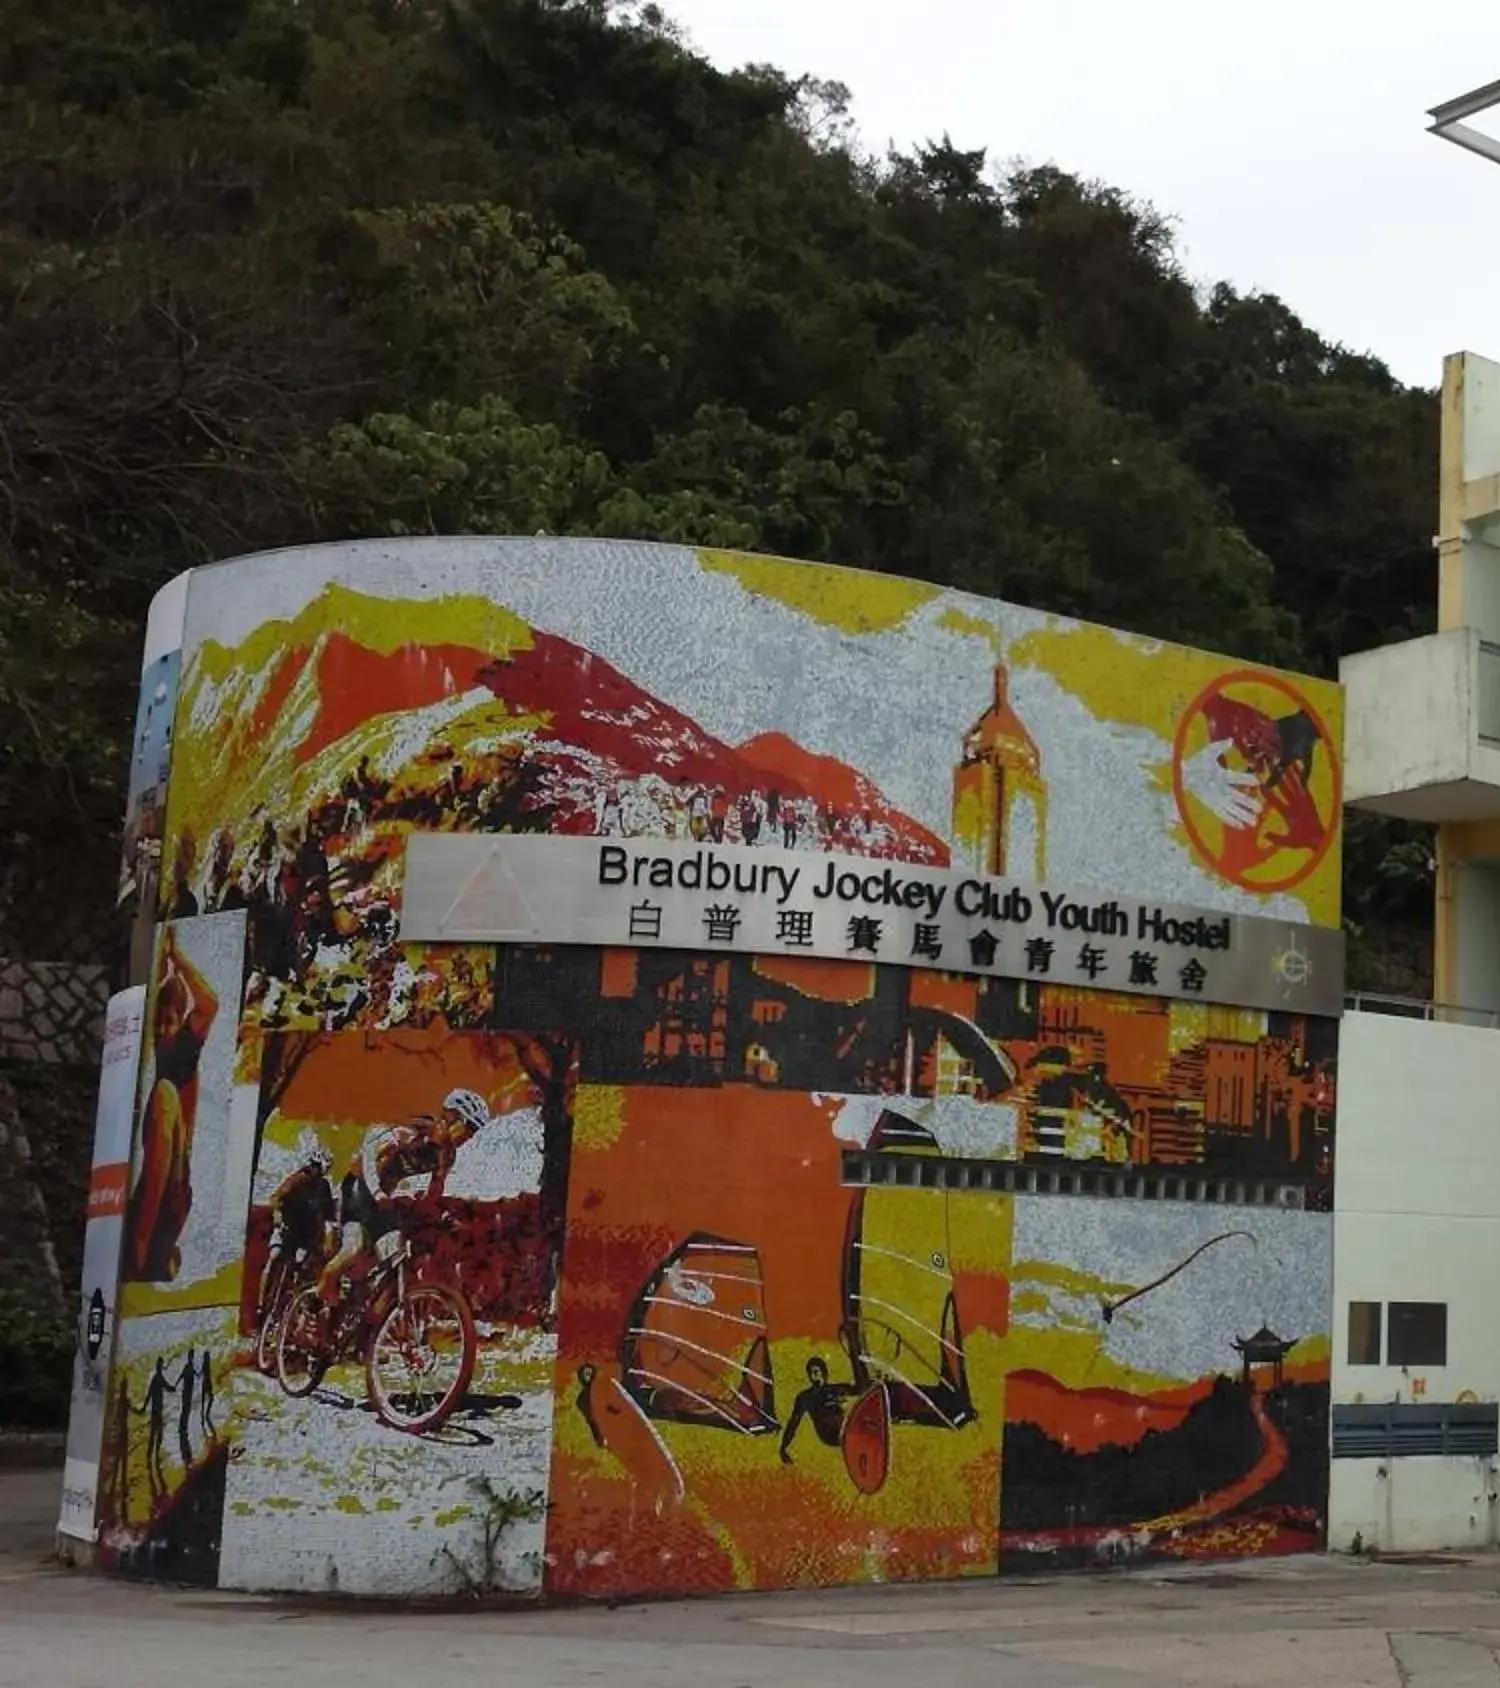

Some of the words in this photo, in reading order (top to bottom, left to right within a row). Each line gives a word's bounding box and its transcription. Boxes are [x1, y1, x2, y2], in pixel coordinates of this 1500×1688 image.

[600, 845, 800, 904] Bradbury
[813, 861, 946, 918] Jockey
[954, 879, 1032, 922] Club
[1040, 892, 1129, 938] Youth
[1137, 906, 1230, 950] Hostel
[628, 900, 1208, 992] 白普理賽馬會青年旅舍
